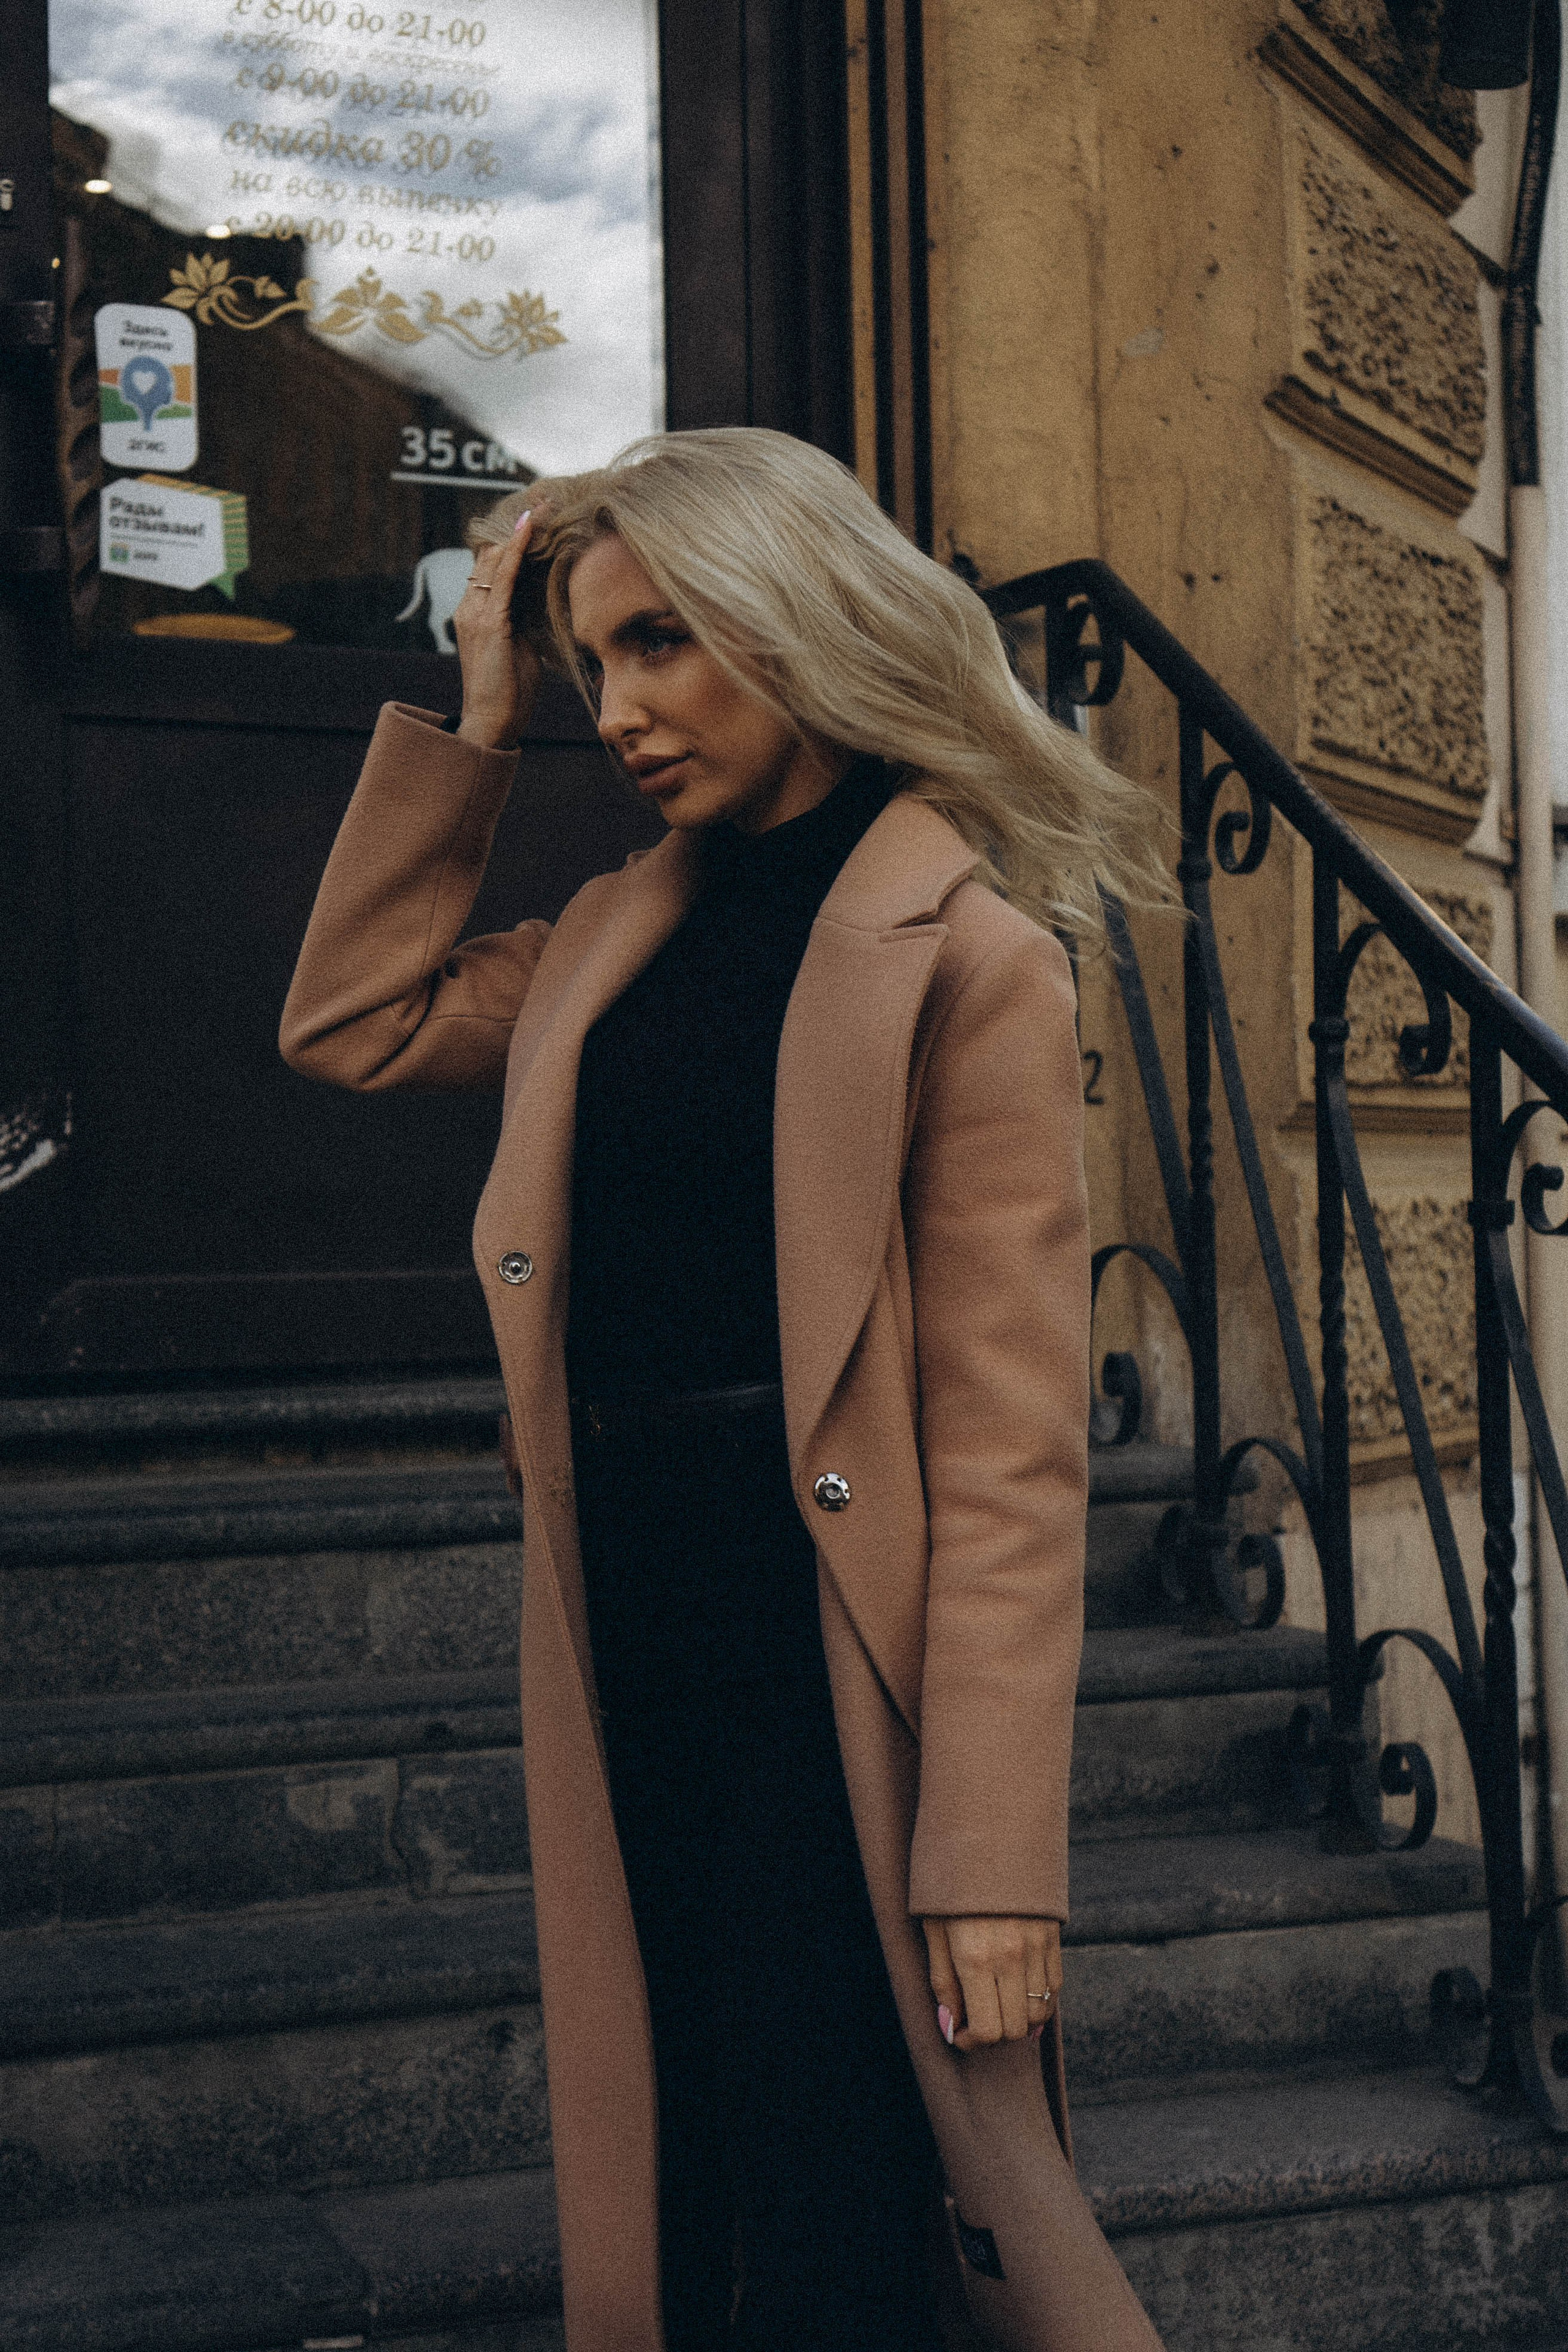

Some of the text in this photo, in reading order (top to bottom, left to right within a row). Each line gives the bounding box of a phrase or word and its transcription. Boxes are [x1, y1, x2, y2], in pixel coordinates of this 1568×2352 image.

[263, 0, 336, 26] 8-00
[347, 3, 385, 32] до
[397, 11, 486, 47] 21-00
[236, 62, 489, 118] с 9-00 до 21-00
[400, 129, 452, 171] 30
[464, 138, 503, 177] %
[230, 170, 502, 219] на всю выпечку
[356, 221, 394, 250] до
[405, 227, 496, 261] 21-00
[400, 426, 457, 469] 35
[109, 496, 164, 518] Рады
